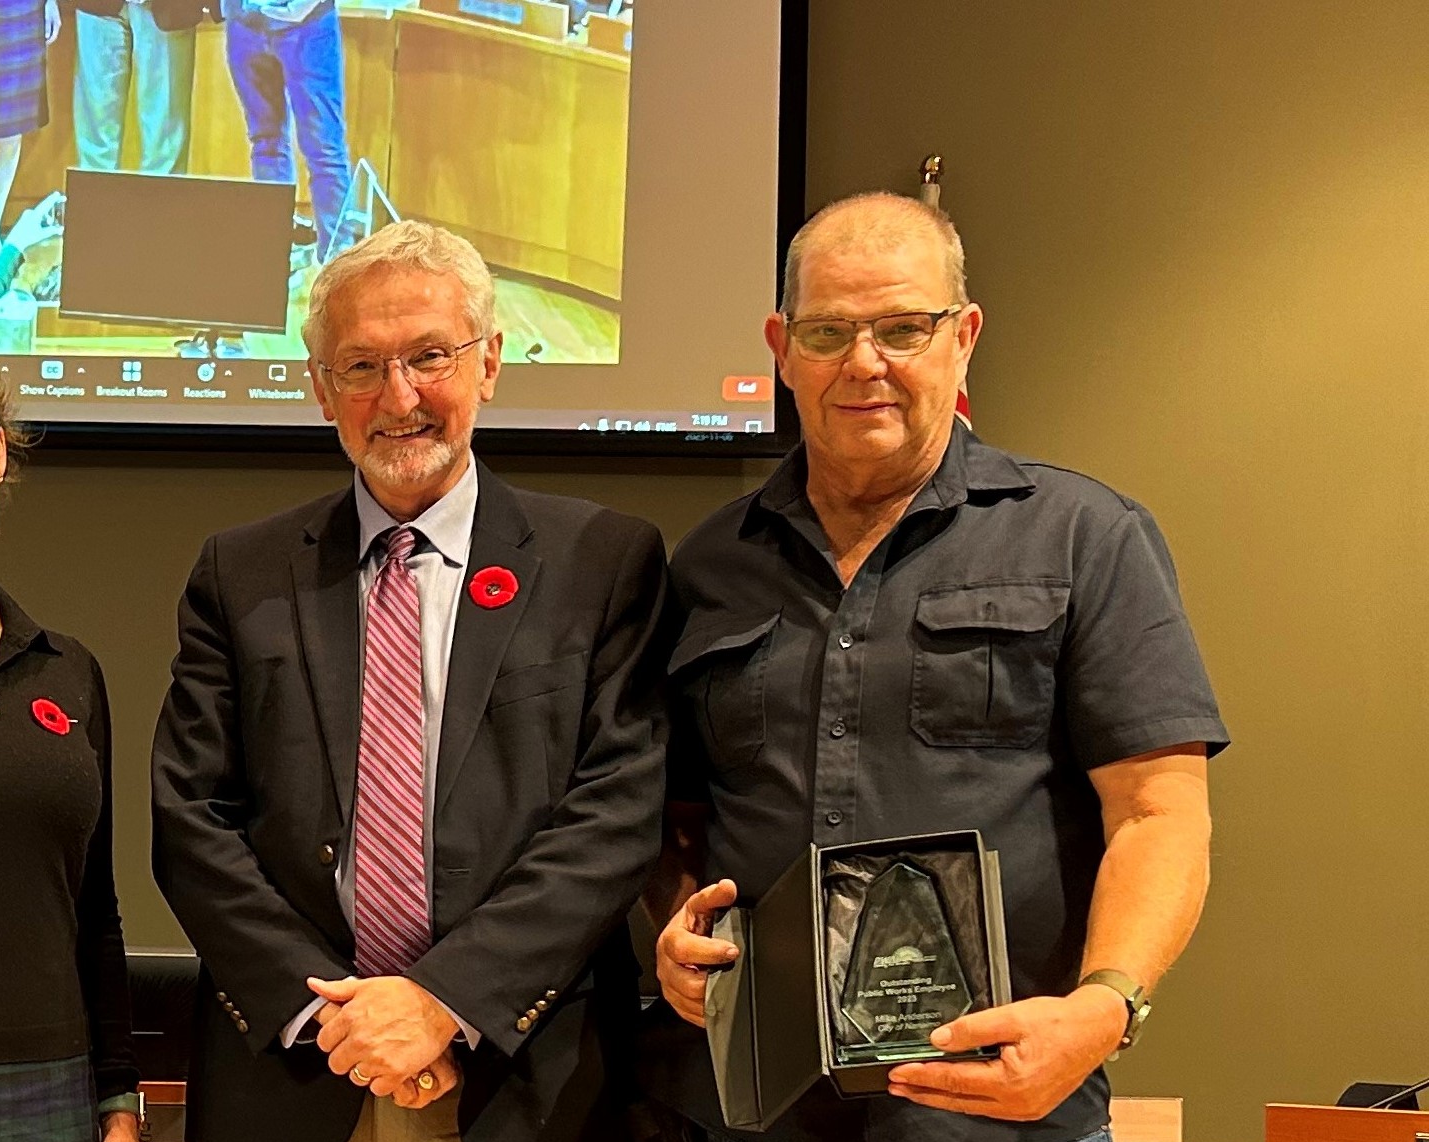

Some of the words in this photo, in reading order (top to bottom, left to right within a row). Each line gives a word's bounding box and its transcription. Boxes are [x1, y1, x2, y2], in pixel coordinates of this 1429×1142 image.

[19, 384, 45, 396] Show
[46, 385, 85, 398] Captions
[96, 386, 135, 397] Breakout
[136, 386, 168, 397] Rooms
[183, 387, 226, 399] Reactions
[248, 388, 305, 400] Whiteboards
[879, 977, 932, 988] Outstanding
[857, 989, 884, 998] Public
[885, 987, 913, 996] Works
[914, 983, 956, 993] Employee
[898, 1011, 942, 1021] Anderson
[877, 1023, 894, 1033] City
